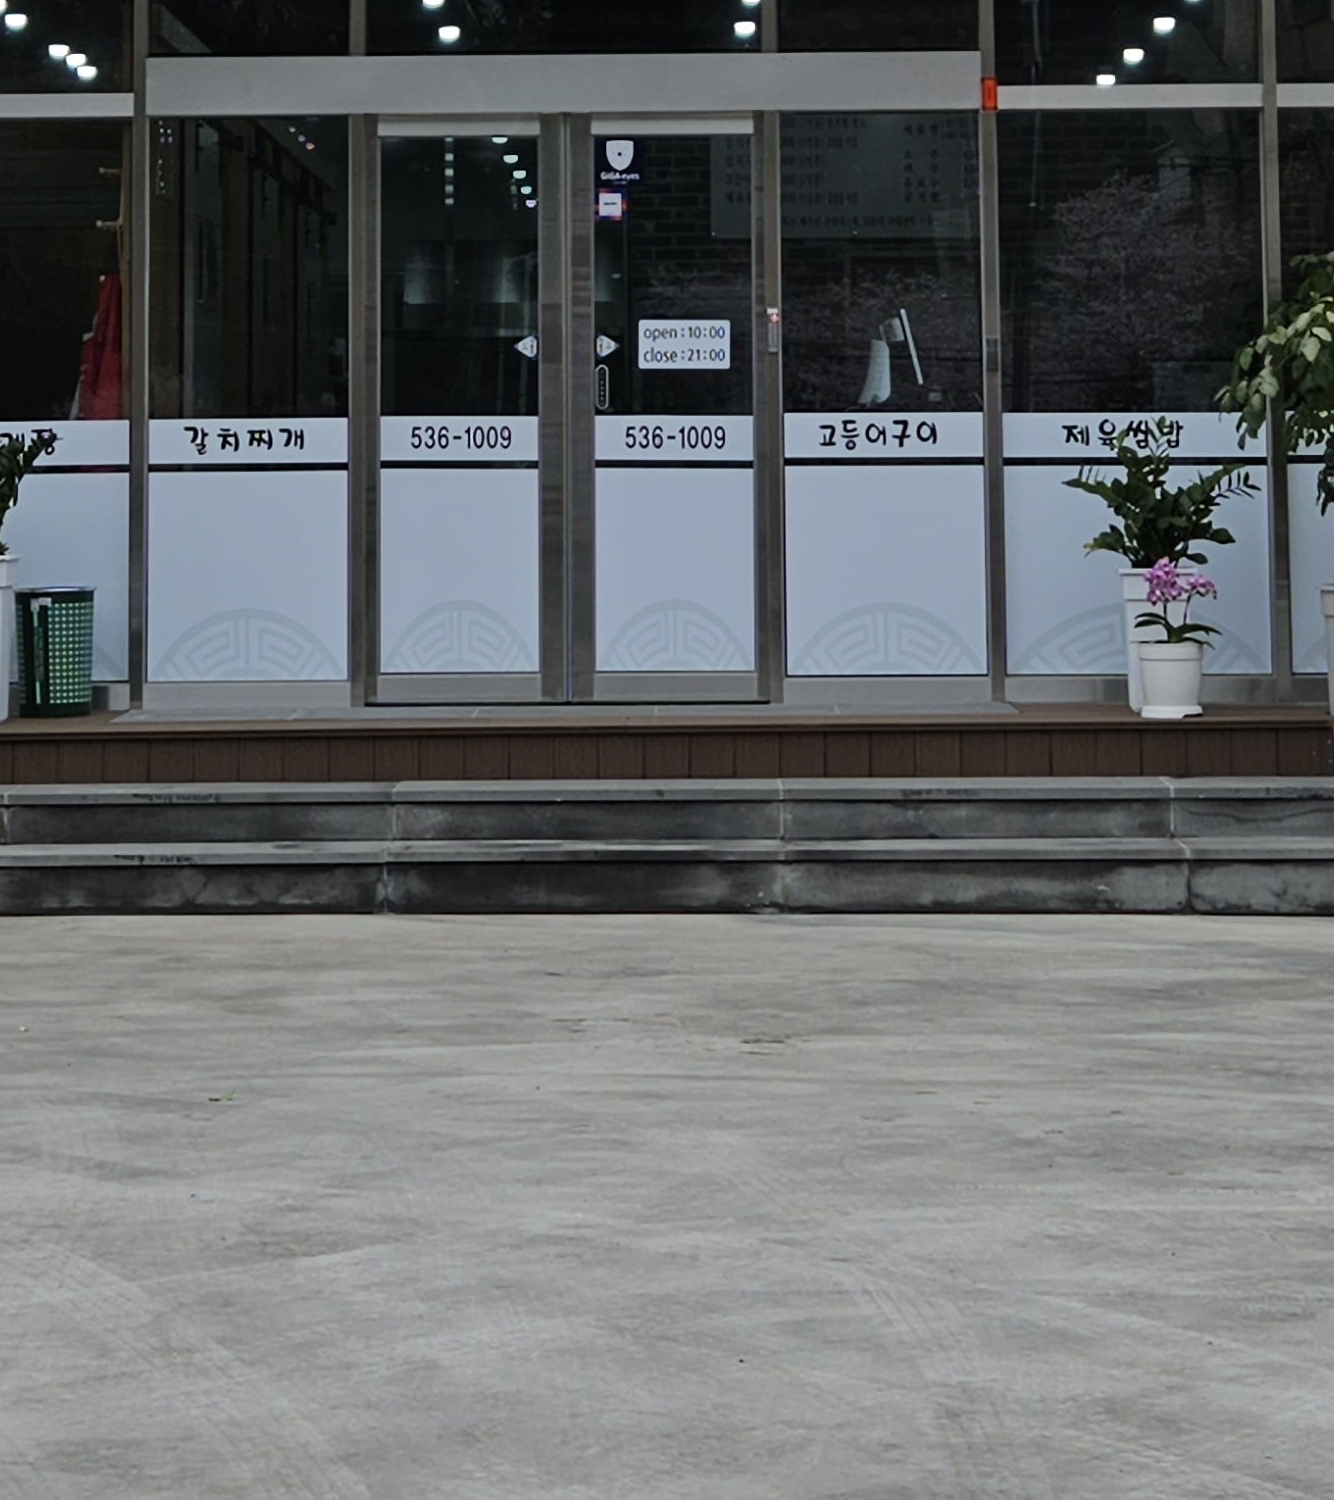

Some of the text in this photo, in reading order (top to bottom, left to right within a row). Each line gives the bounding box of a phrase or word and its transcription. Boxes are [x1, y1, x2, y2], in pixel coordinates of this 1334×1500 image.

[183, 426, 305, 455] 갈치찌개
[410, 426, 512, 450] 536-1009
[625, 425, 726, 449] 536-1009
[818, 419, 938, 451] 고등어구이
